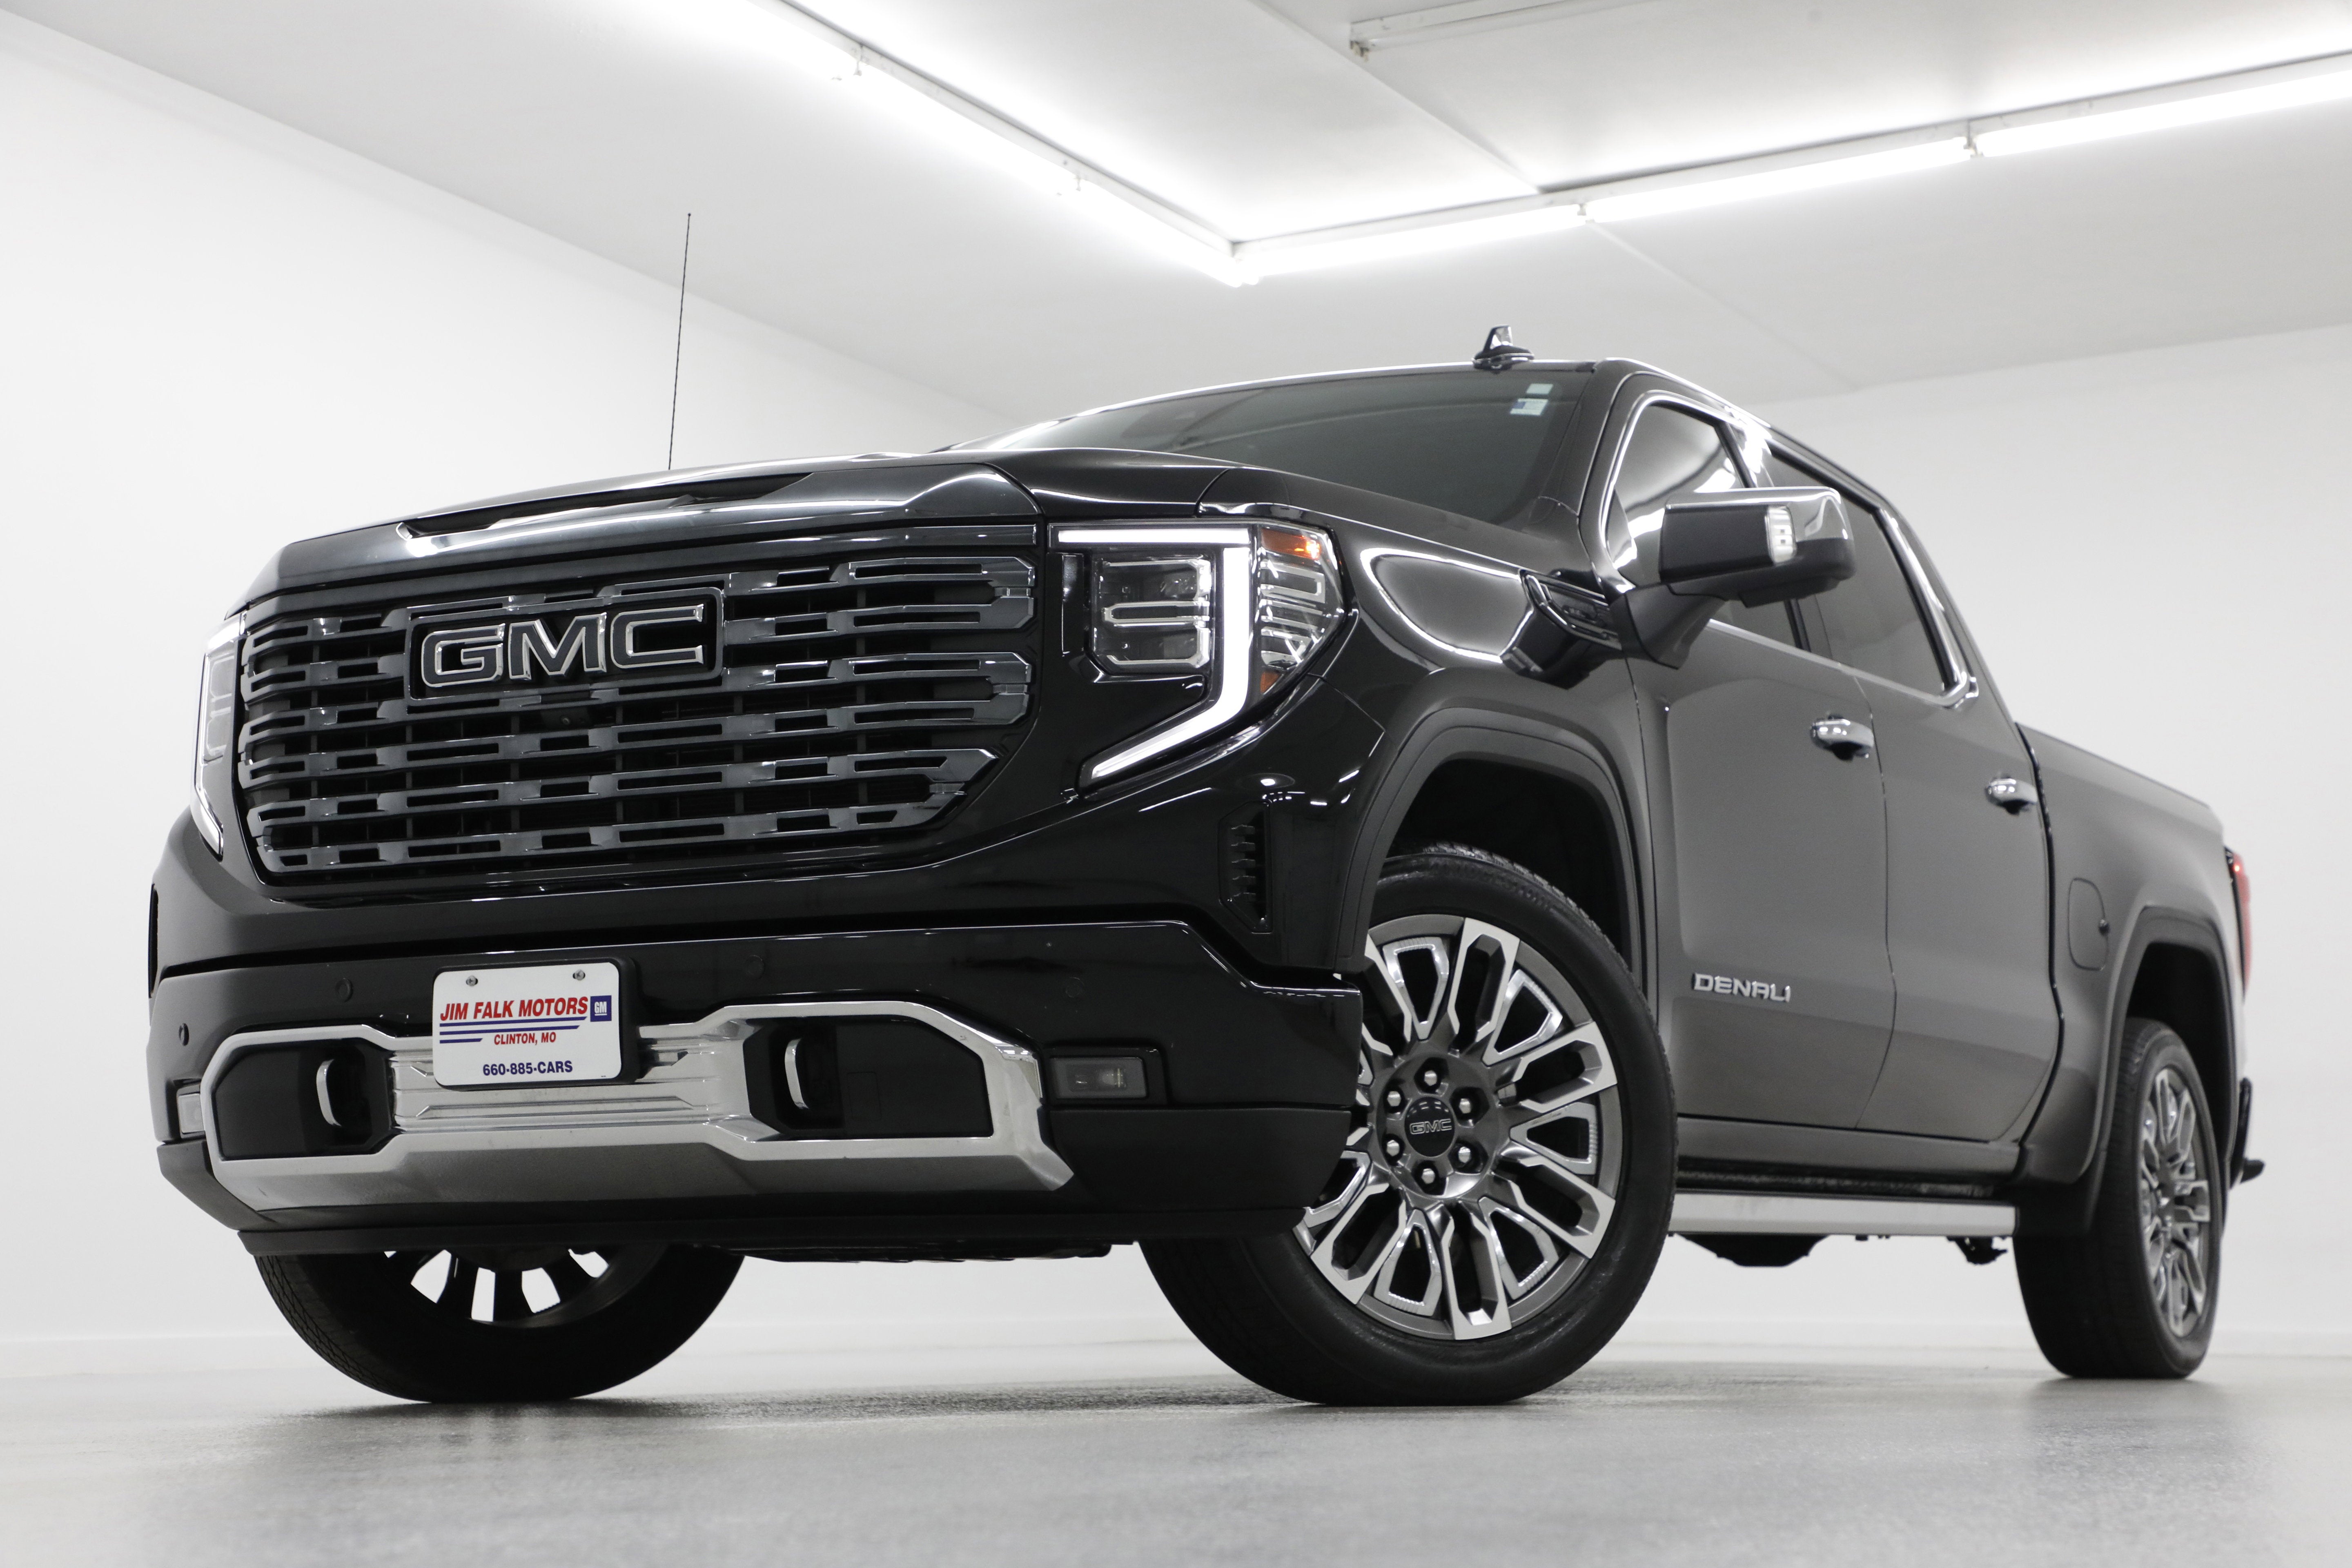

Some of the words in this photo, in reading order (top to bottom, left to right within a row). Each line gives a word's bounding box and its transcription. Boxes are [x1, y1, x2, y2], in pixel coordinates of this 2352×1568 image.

[421, 603, 705, 688] GMC
[1693, 973, 1791, 1002] DENALI
[440, 1003, 468, 1021] JIM
[473, 1000, 514, 1019] FALK
[519, 996, 588, 1017] MOTORS
[594, 1001, 607, 1014] GM
[494, 1032, 538, 1045] CLINTON,
[541, 1031, 556, 1042] MO
[483, 1060, 573, 1076] 660-885-CARS
[1410, 1118, 1452, 1135] GMC
